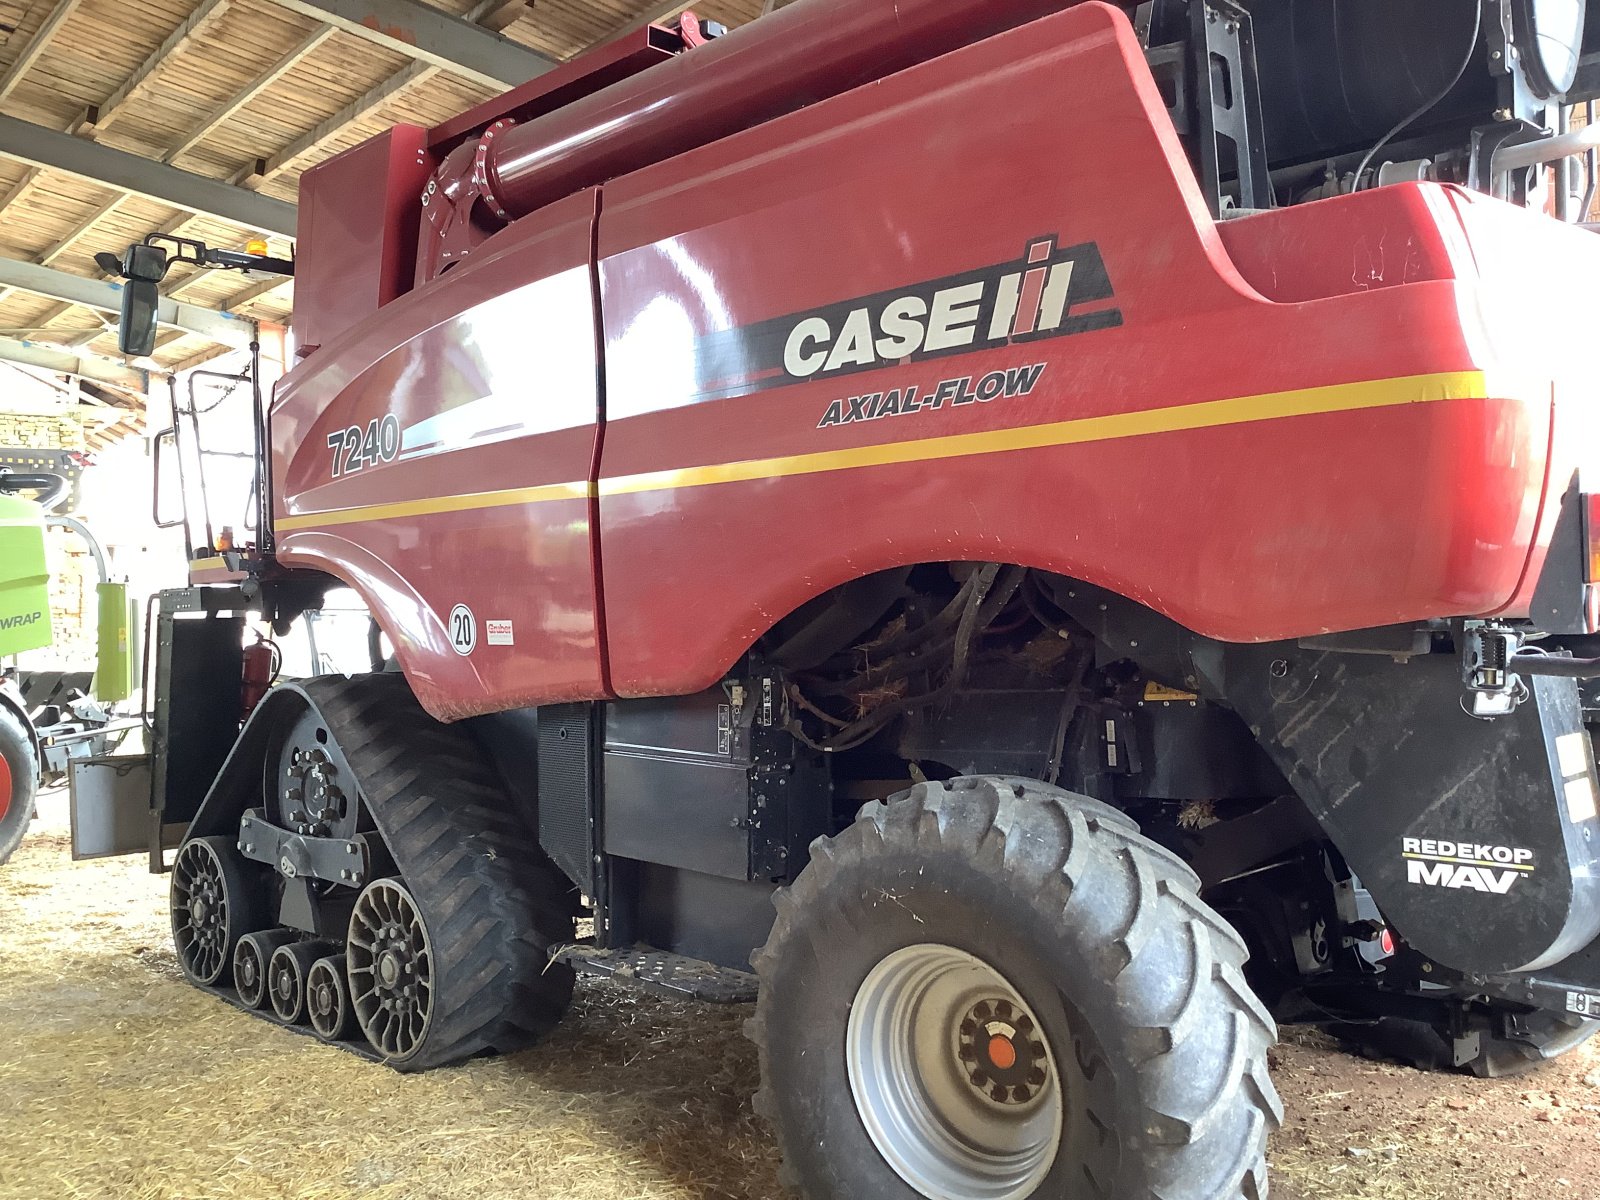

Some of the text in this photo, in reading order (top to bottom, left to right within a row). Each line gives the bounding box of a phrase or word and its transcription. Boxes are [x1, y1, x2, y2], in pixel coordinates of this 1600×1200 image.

[783, 280, 985, 377] CASE
[816, 362, 1049, 429] AXIAL-FLOW
[327, 413, 400, 478] 7240
[454, 613, 472, 646] 20
[1402, 837, 1533, 864] REDEKOP
[1407, 860, 1519, 894] MAV
